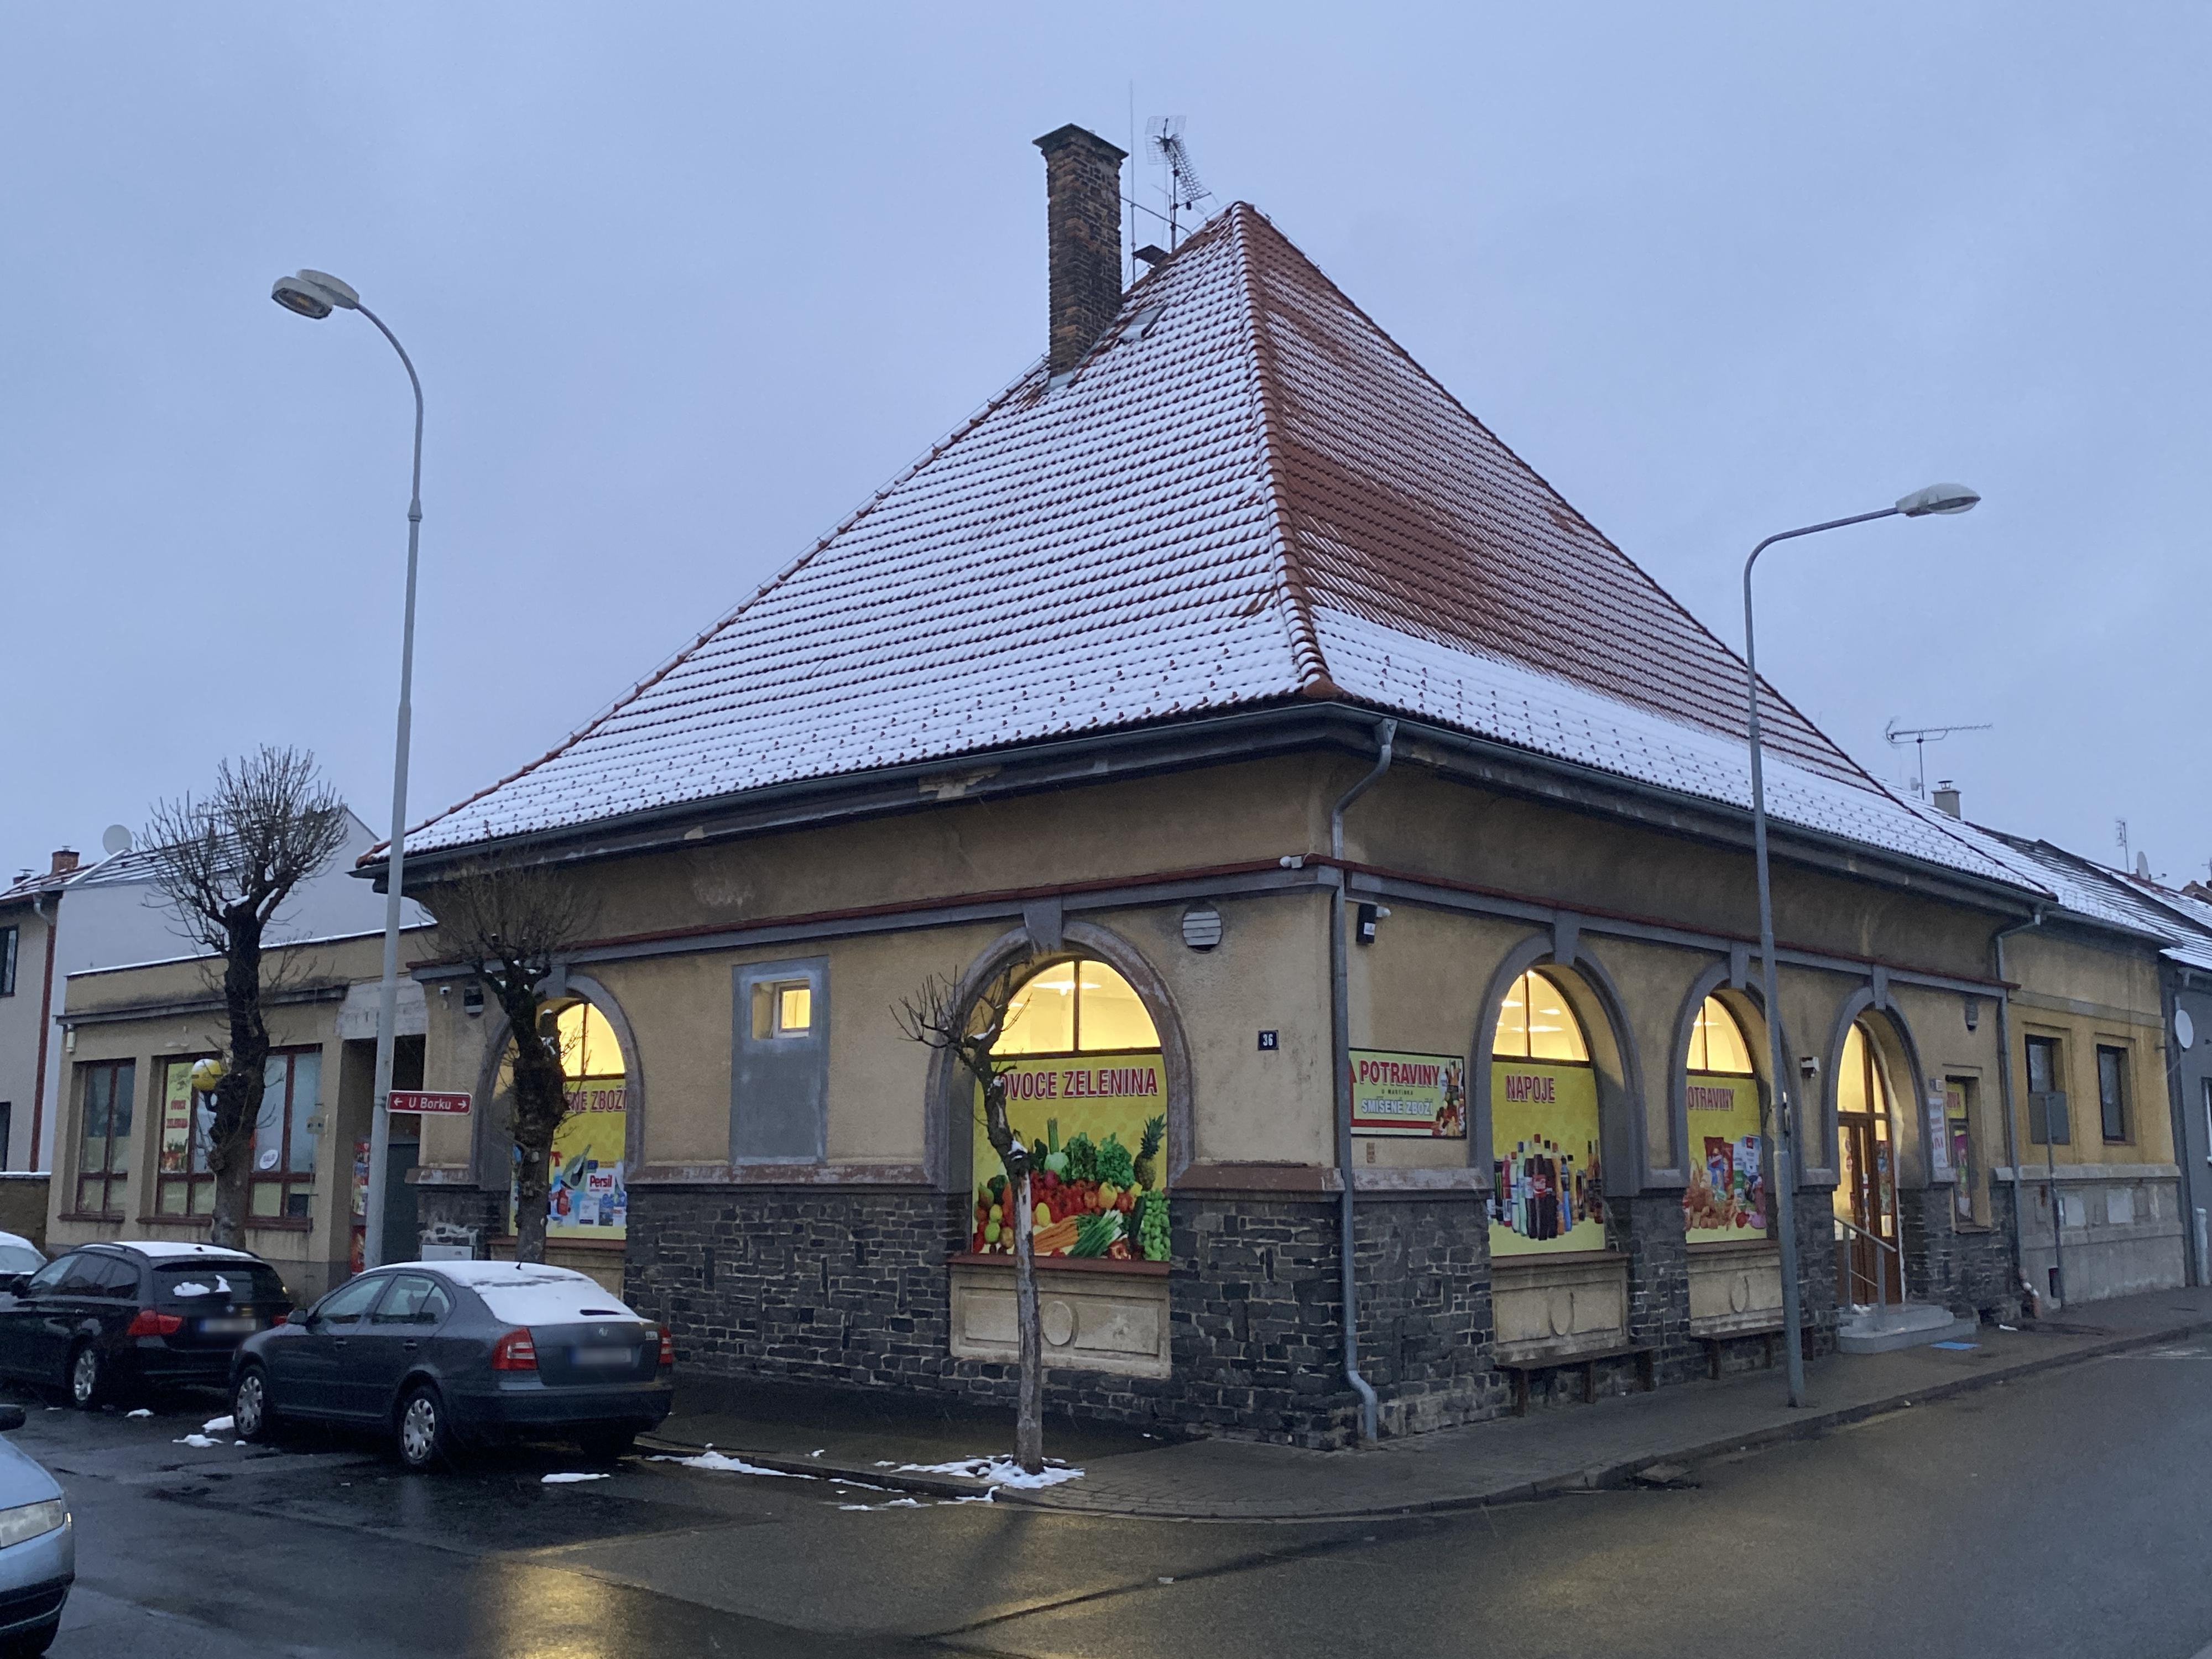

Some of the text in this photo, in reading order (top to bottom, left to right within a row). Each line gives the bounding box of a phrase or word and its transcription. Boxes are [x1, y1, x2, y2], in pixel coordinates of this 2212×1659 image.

[1263, 1034, 1273, 1046] 36
[1062, 1068, 1159, 1098] ZELENINA
[1359, 1060, 1439, 1088] POTRAVINY
[1506, 1070, 1555, 1103] NÁPOJE
[409, 1097, 451, 1109] U Borku
[1361, 1095, 1433, 1116] SMÍŠENÉ ZBOŽÍ
[1687, 1086, 1734, 1111] OTRAVINY
[590, 1175, 612, 1187] Persil
